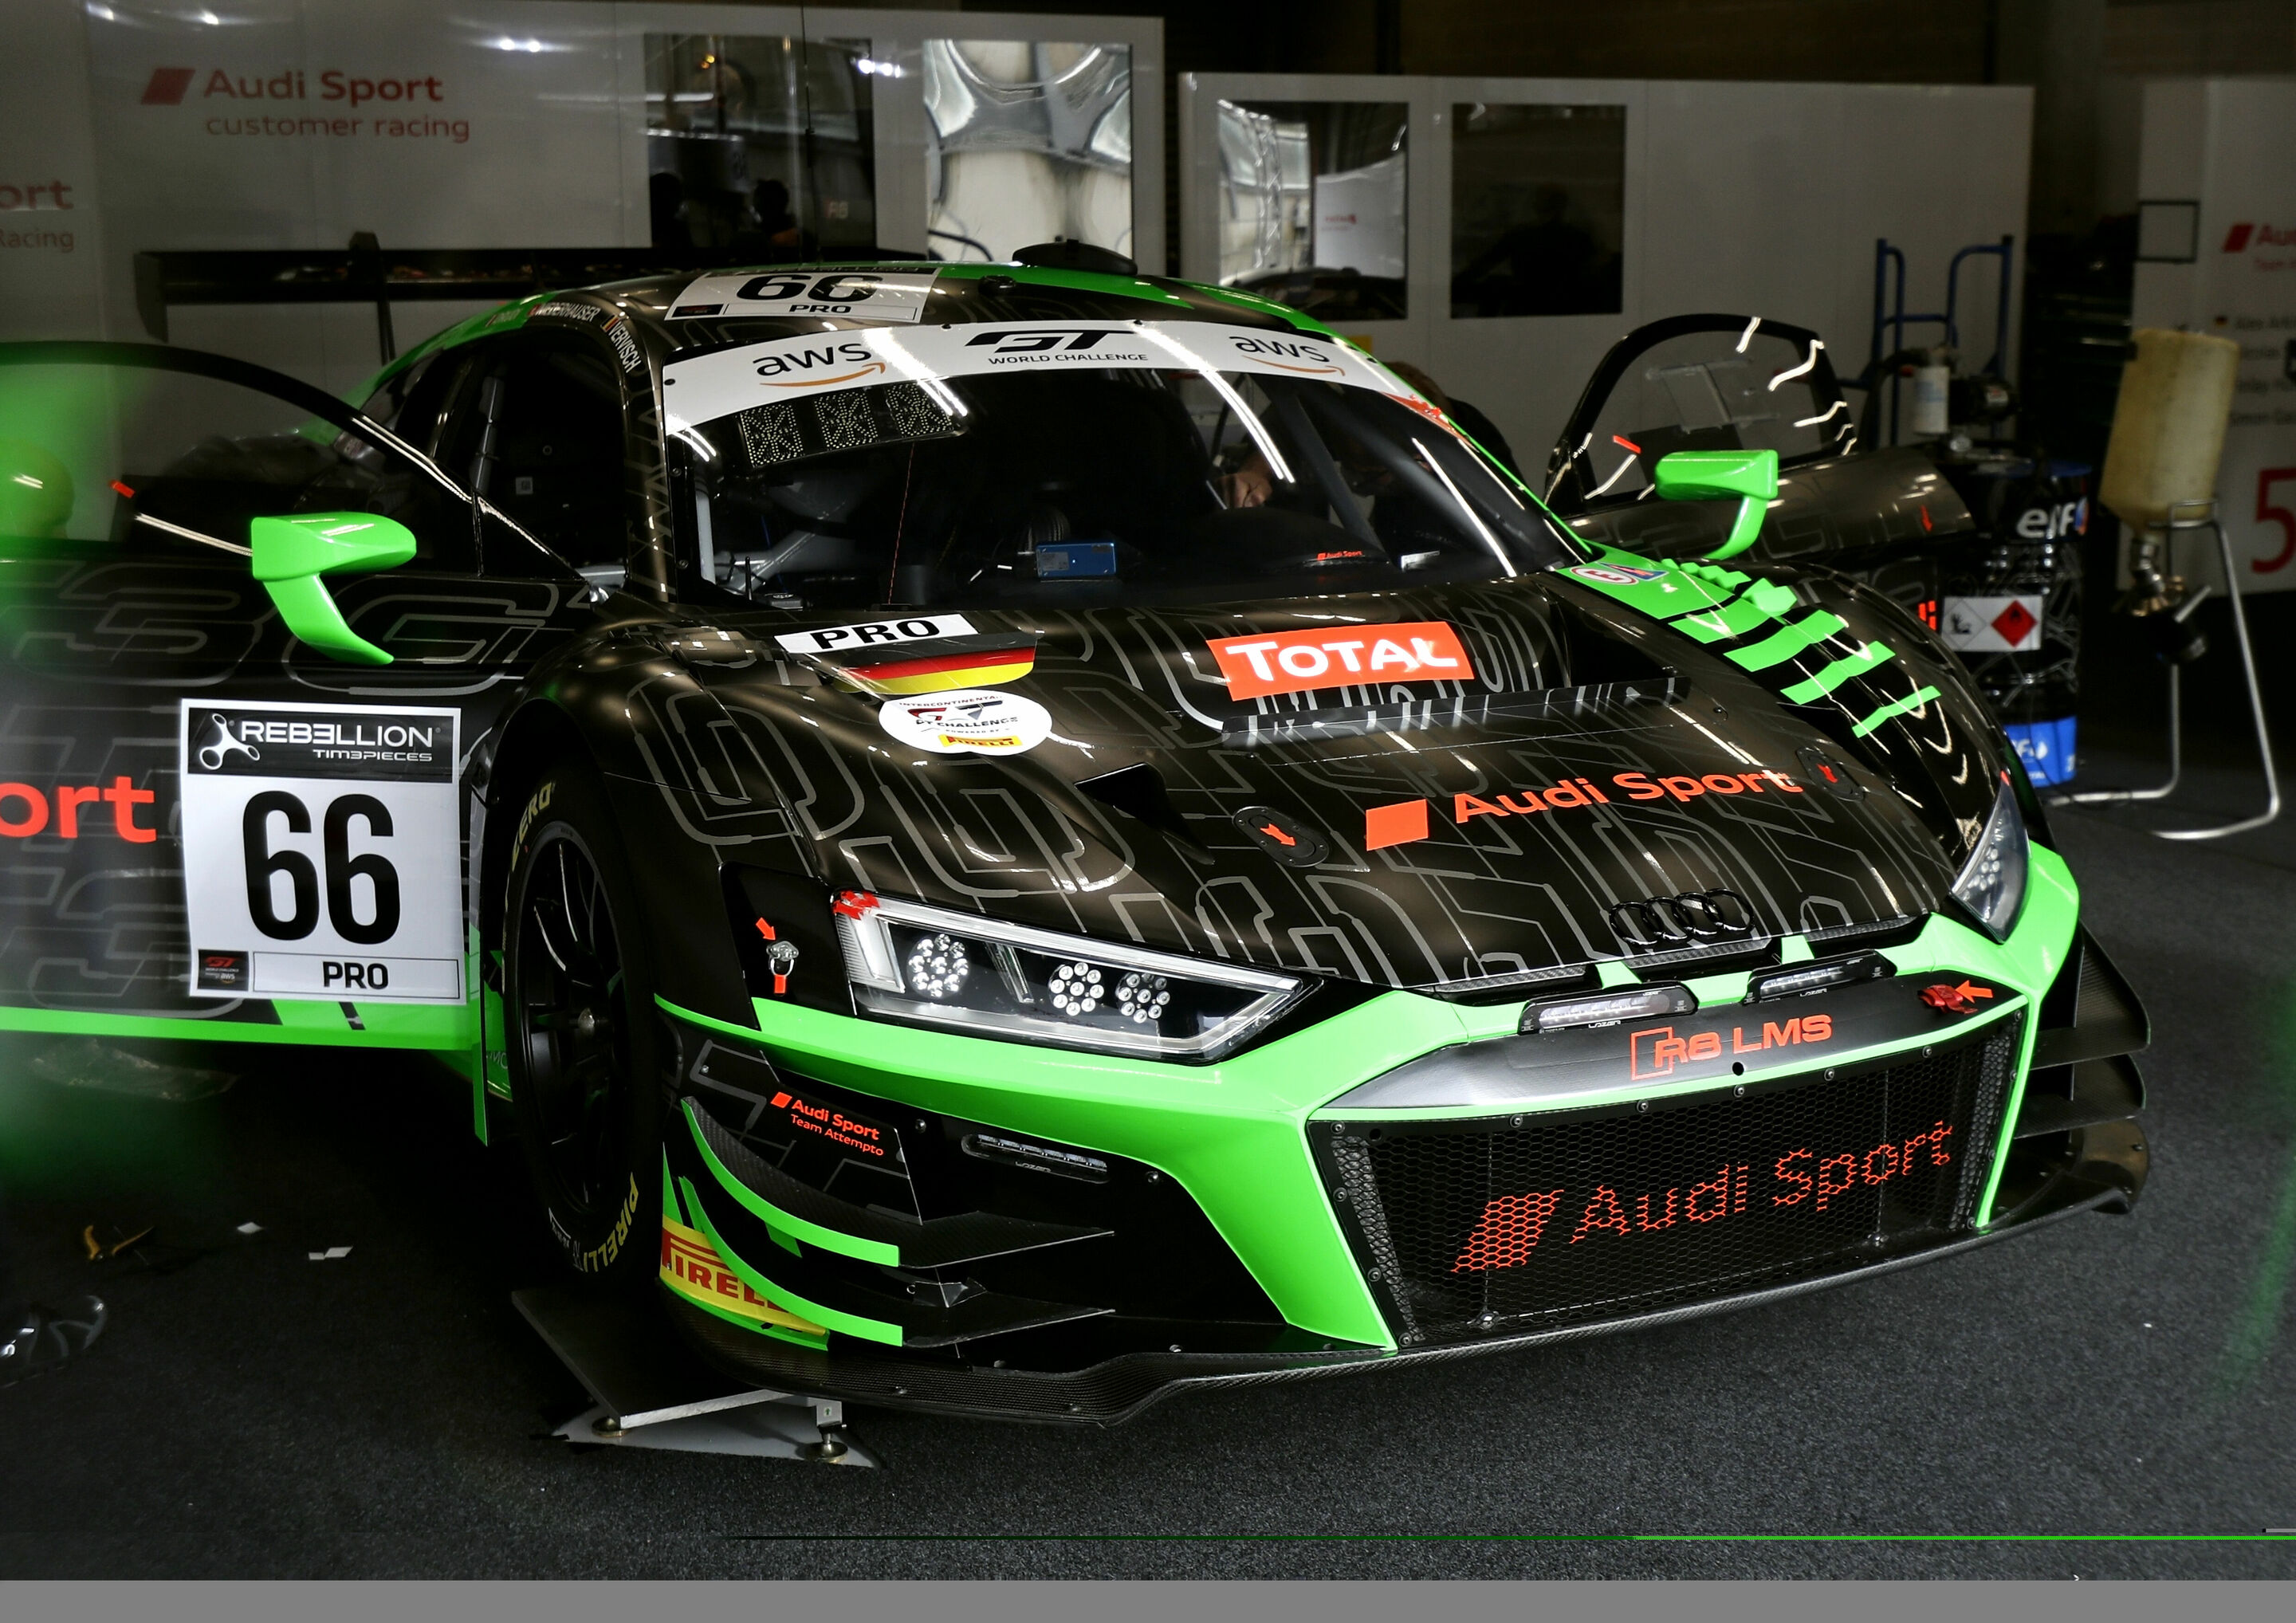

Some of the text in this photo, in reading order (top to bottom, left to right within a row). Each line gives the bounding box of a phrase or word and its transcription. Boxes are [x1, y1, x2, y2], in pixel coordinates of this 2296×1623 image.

[202, 68, 445, 108] Audi Sport
[204, 113, 471, 145] customer racing
[788, 304, 852, 314] PRO
[608, 320, 643, 374] VERVISCH
[753, 344, 872, 377] aws
[965, 329, 1136, 353] GT
[988, 353, 1149, 365] WORLD CHALLENGE
[1229, 336, 1331, 363] aws
[2015, 501, 2076, 539] elf
[810, 619, 941, 650] PRO
[1225, 636, 1458, 682] TOTAL
[899, 695, 1003, 707] INTERCONTINENTA
[241, 721, 433, 748] REBELLION
[946, 735, 1015, 746] PIRELLI
[0, 776, 157, 843] ort
[1454, 768, 1804, 824] Audi Sport
[242, 790, 400, 945] 66
[322, 961, 389, 990] PRO
[1654, 1013, 1833, 1068] R8 LMS
[790, 1114, 884, 1157] Team Attempto
[791, 1099, 880, 1141] Audi Sport
[1568, 1120, 1953, 1244] Audi Sport
[583, 1170, 639, 1274] PIRELLI
[661, 1226, 790, 1315] PIREL
